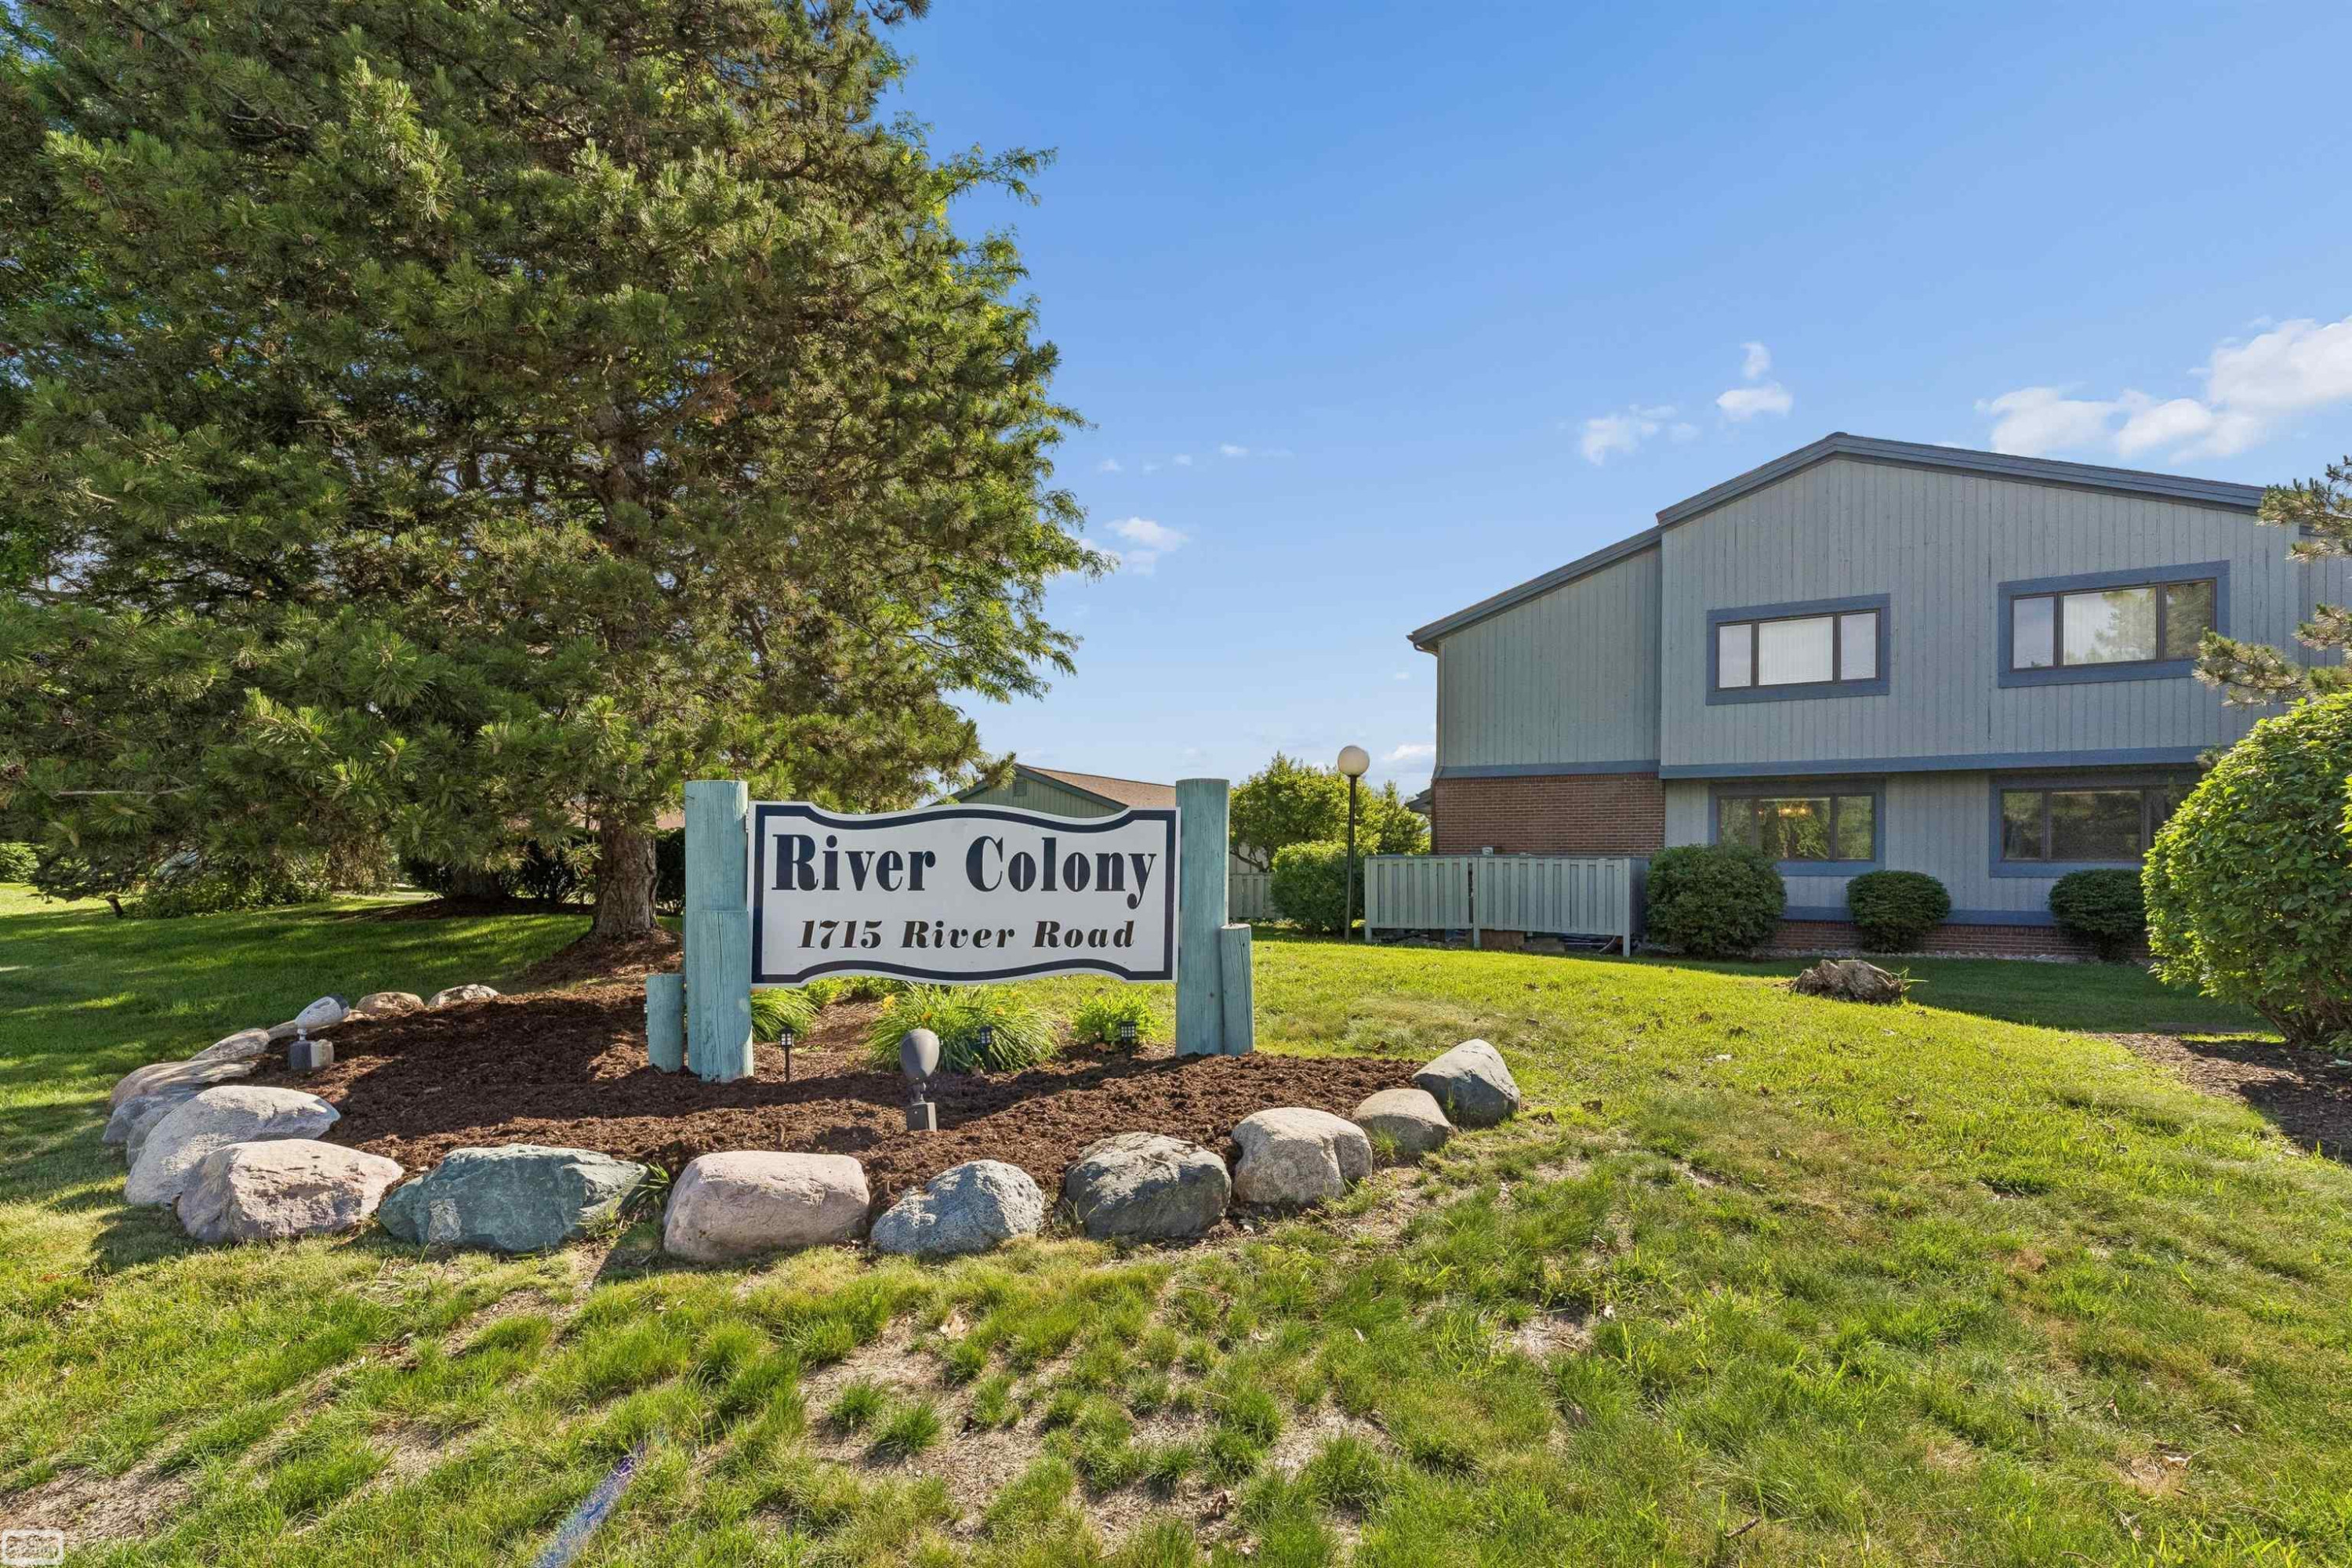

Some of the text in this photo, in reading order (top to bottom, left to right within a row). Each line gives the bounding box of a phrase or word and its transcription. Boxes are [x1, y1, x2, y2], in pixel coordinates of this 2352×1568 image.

[771, 833, 1157, 909] River Colony
[798, 920, 1134, 949] 1715 River Road
